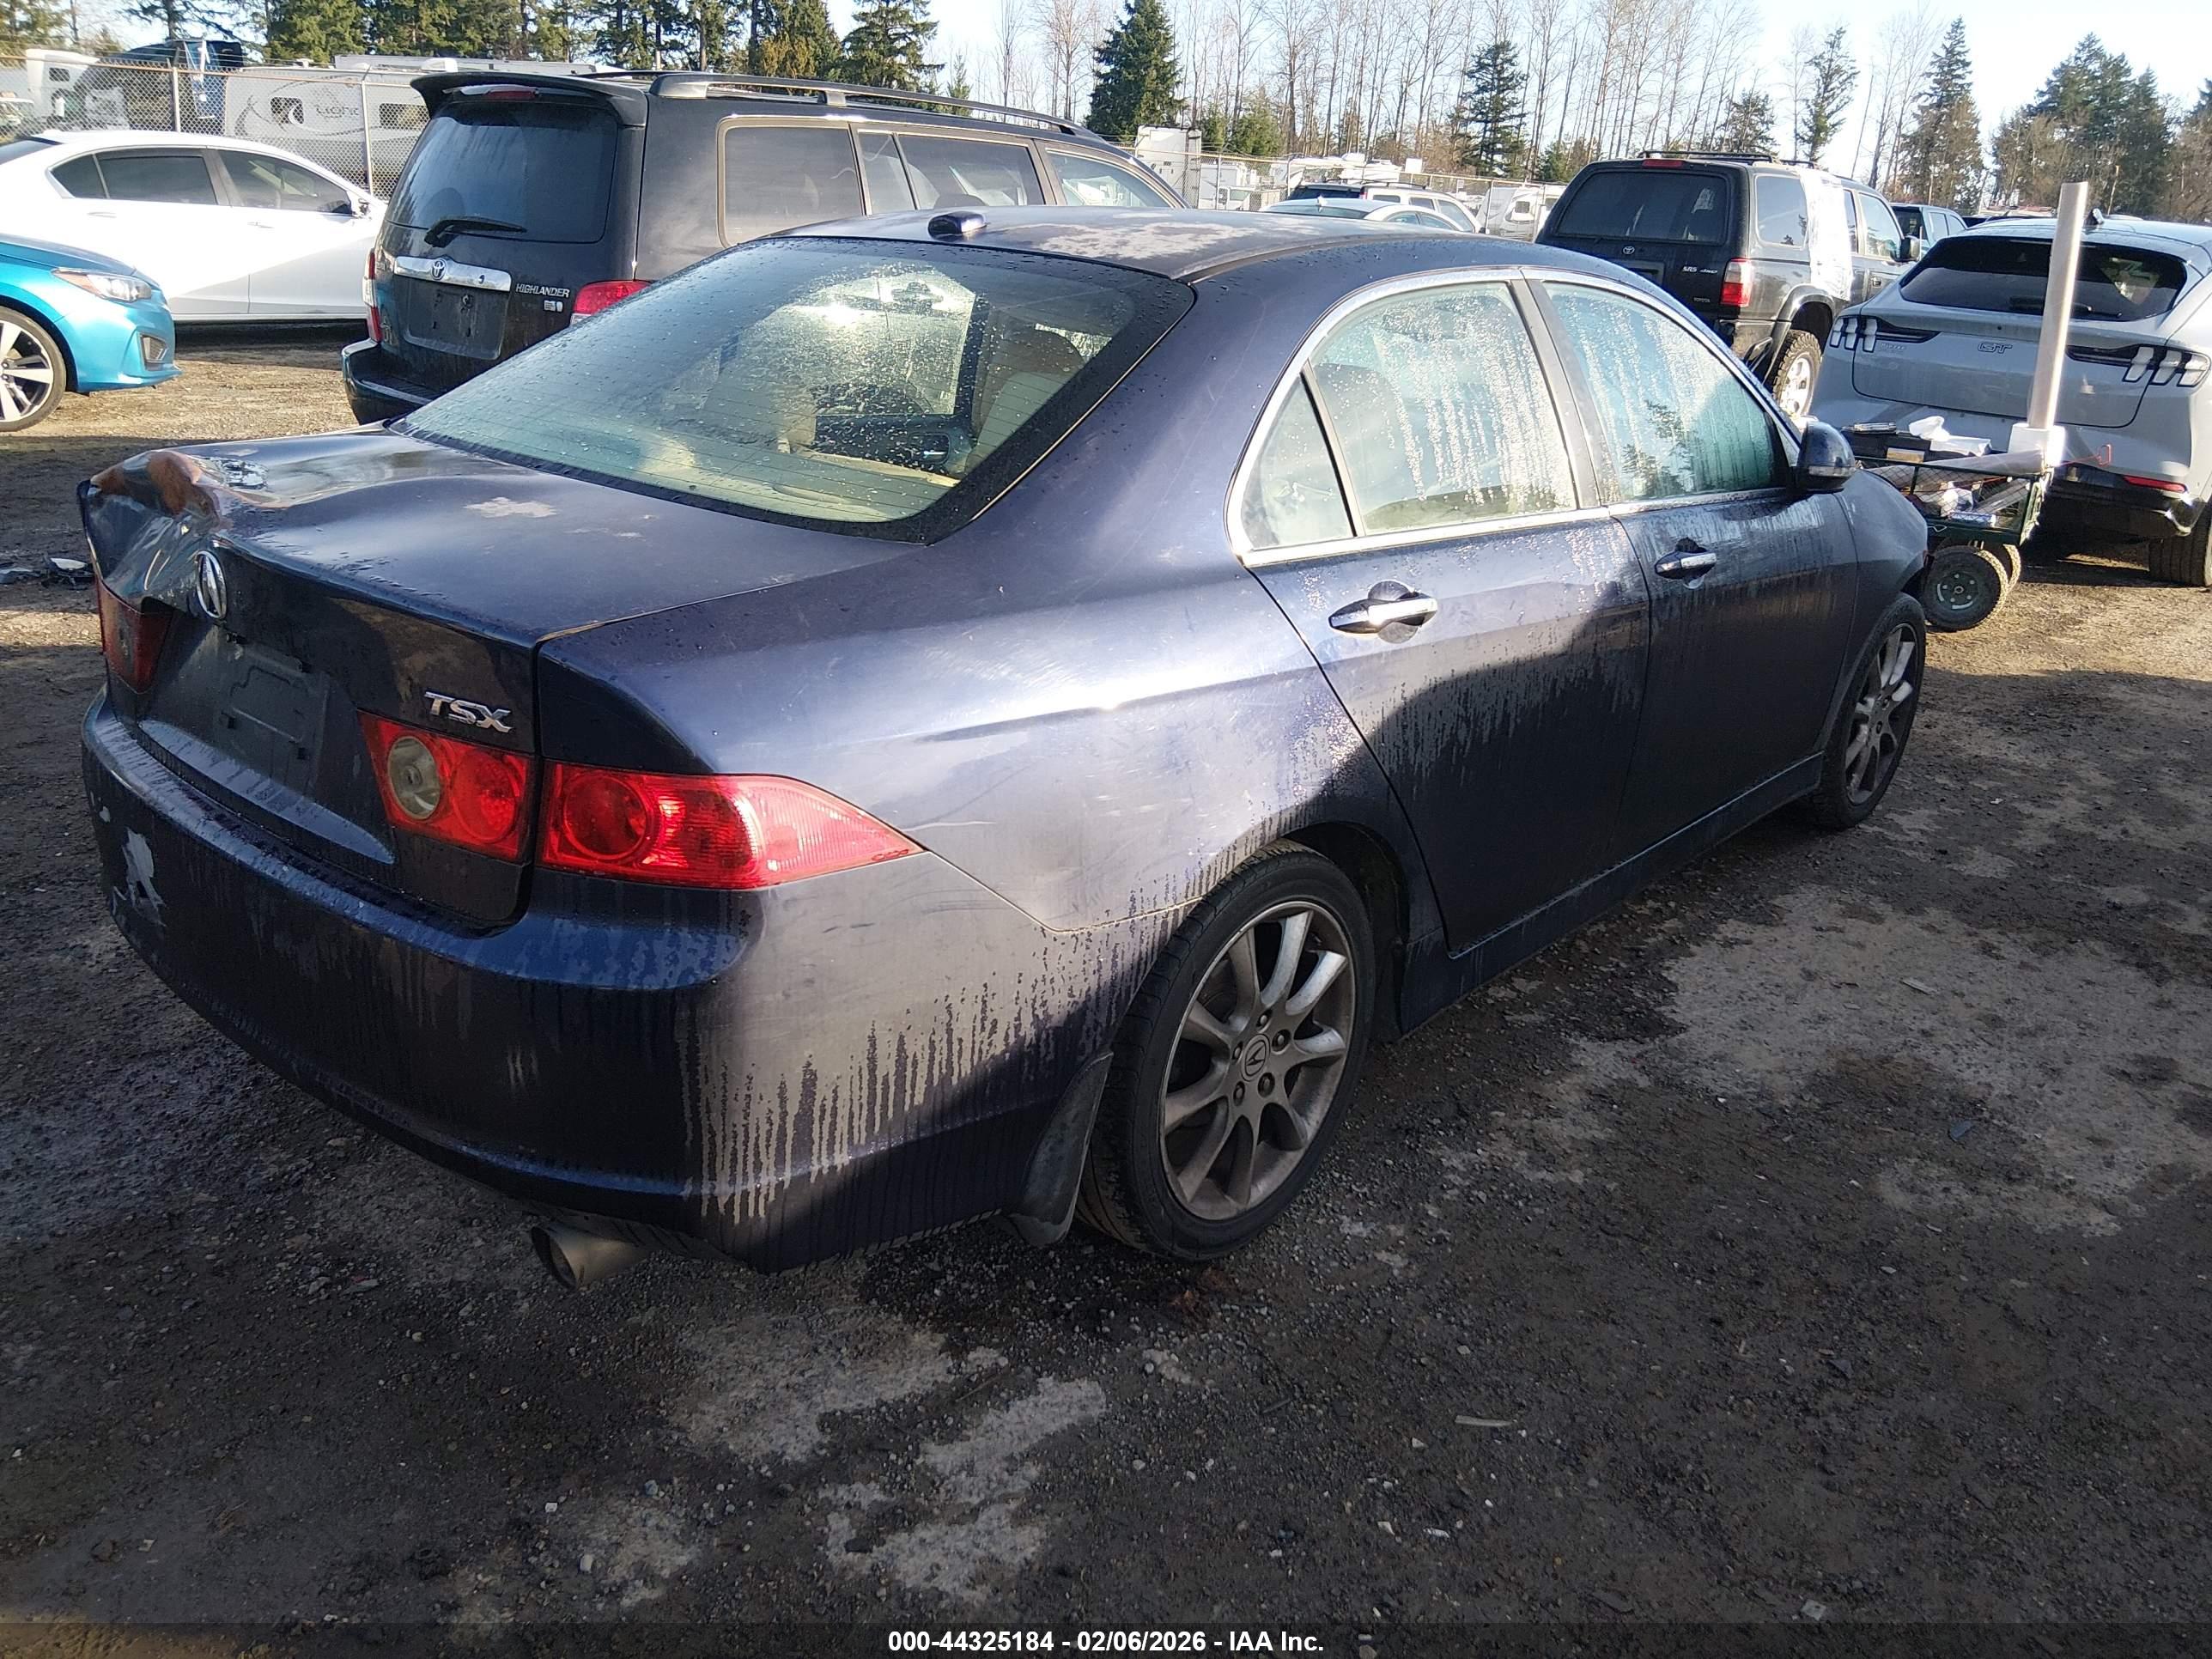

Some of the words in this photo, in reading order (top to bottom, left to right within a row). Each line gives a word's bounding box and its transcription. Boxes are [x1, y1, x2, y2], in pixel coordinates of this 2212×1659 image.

[515, 283, 571, 299] HIGHLANDER
[1977, 342, 2013, 355] GT
[424, 690, 513, 733] TSX
